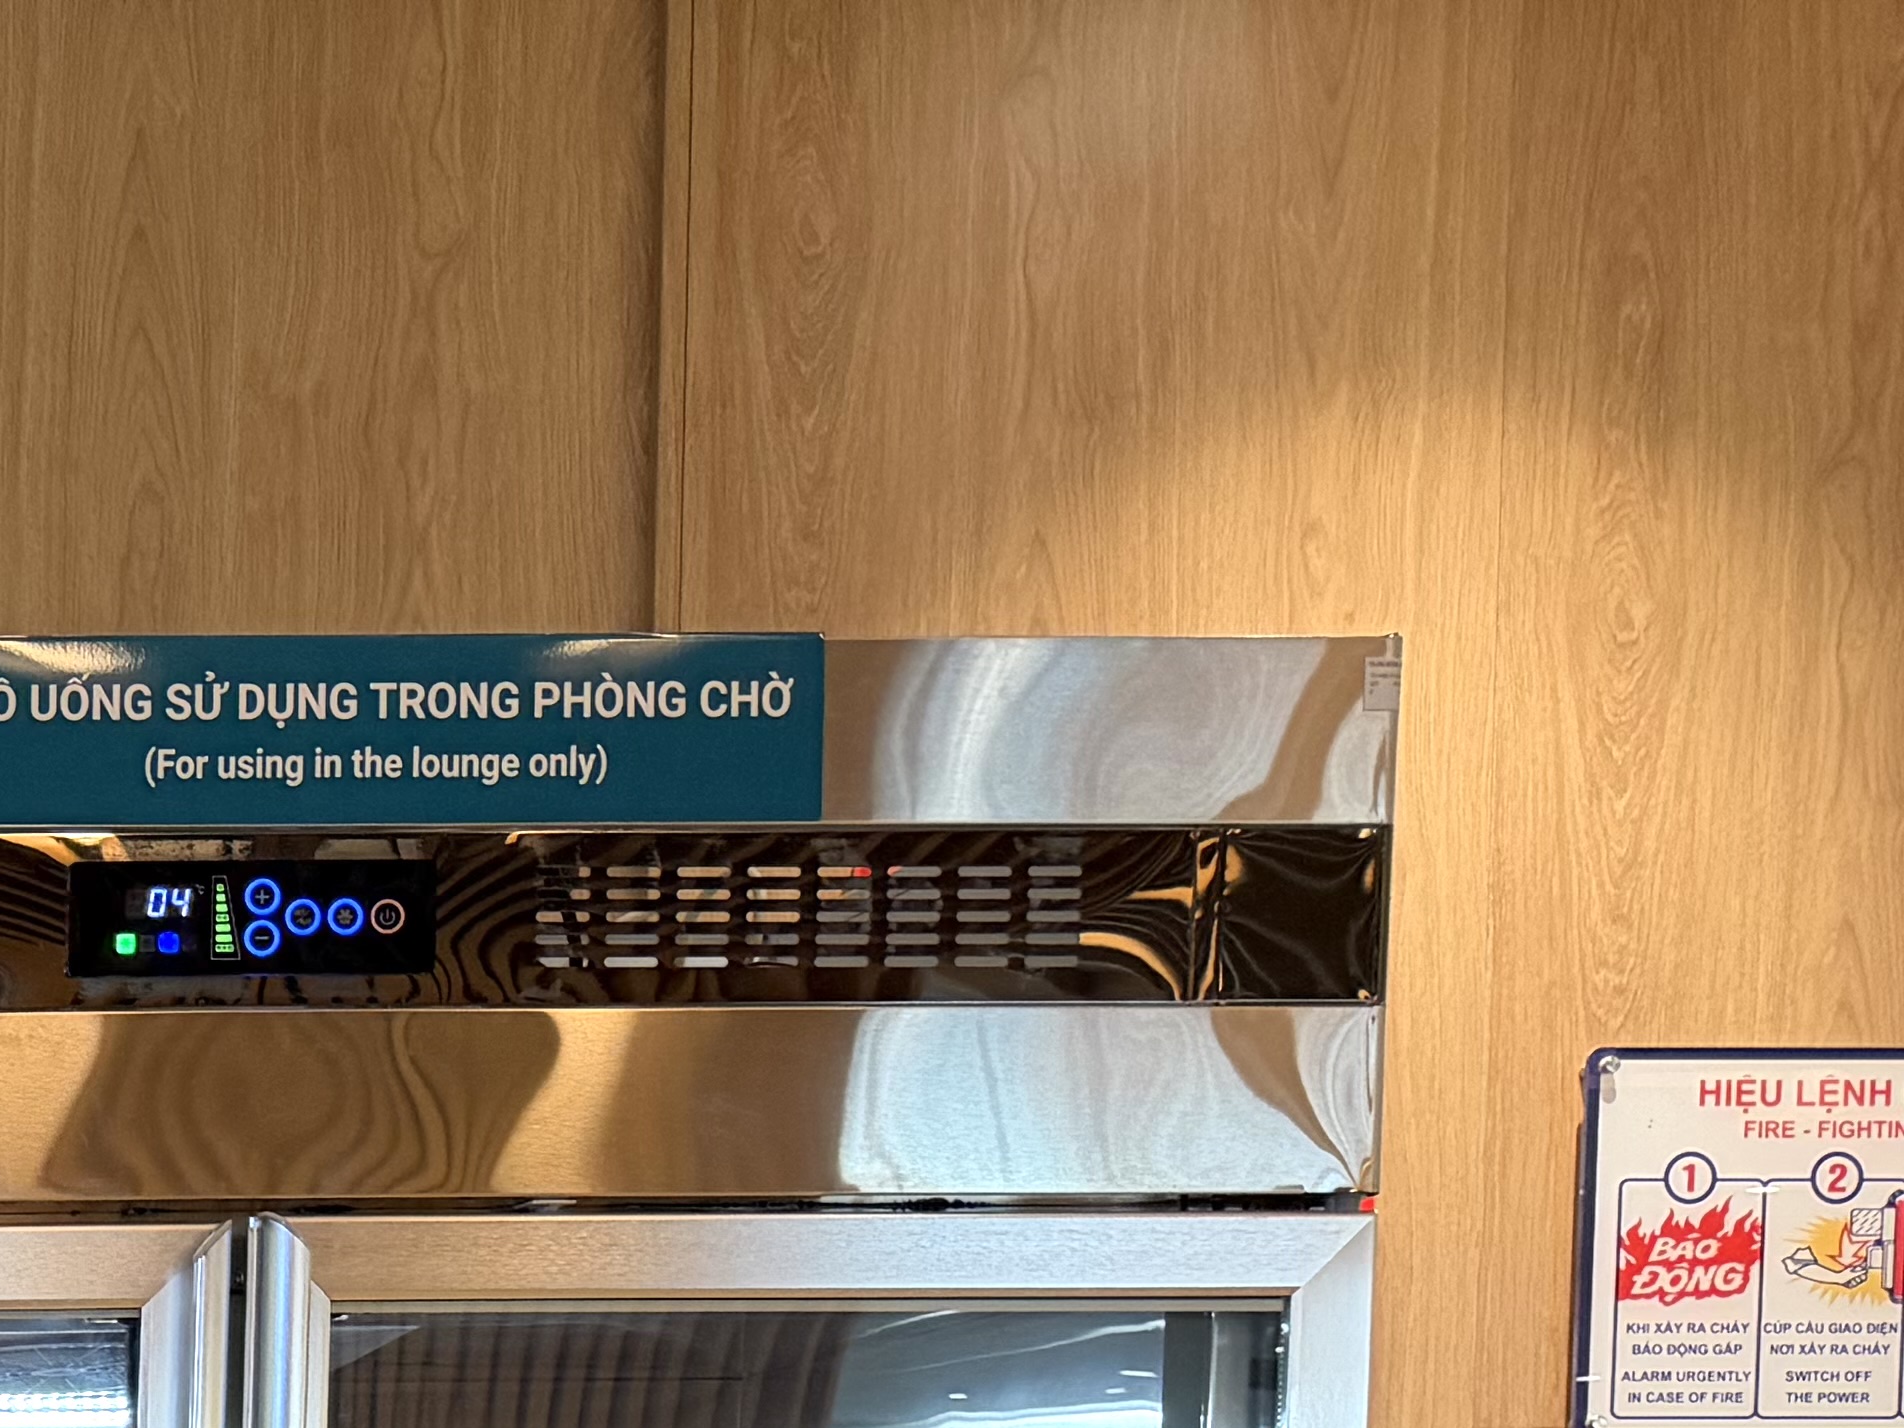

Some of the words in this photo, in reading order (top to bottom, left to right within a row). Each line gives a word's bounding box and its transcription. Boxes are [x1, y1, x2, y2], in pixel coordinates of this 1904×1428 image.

[30, 673, 153, 722] UỐNG
[165, 671, 229, 722] SỬ
[237, 681, 359, 729] DỤNG
[370, 681, 520, 720] TRONG
[533, 672, 687, 719] PHÒNG
[700, 671, 794, 718] CHỜ
[144, 745, 209, 788] (For
[217, 746, 304, 787] using
[314, 746, 343, 779] in
[351, 745, 403, 779] the
[412, 745, 520, 785] lounge
[529, 743, 608, 785] only)
[146, 887, 191, 918] 04
[1698, 1074, 1783, 1114] HIỆU
[1796, 1074, 1892, 1114] LỆNH
[1743, 1120, 1796, 1139] FIRE
[1682, 1164, 1695, 1193] 1
[1828, 1163, 1847, 1193] 2
[1687, 1322, 1706, 1334] RA
[1828, 1322, 1863, 1334] GIAO
[1830, 1343, 1849, 1355] RA
[1621, 1371, 1672, 1382] ALARM
[1676, 1371, 1752, 1383] URGENTLY
[1785, 1371, 1840, 1383] SWITCH
[1844, 1371, 1872, 1382] OFF
[1628, 1392, 1642, 1404] IN
[1646, 1392, 1684, 1404] CASE
[1688, 1392, 1708, 1404] OF
[1712, 1392, 1744, 1404] FIRE
[1786, 1392, 1813, 1404] THE
[1818, 1392, 1870, 1404] POWER
